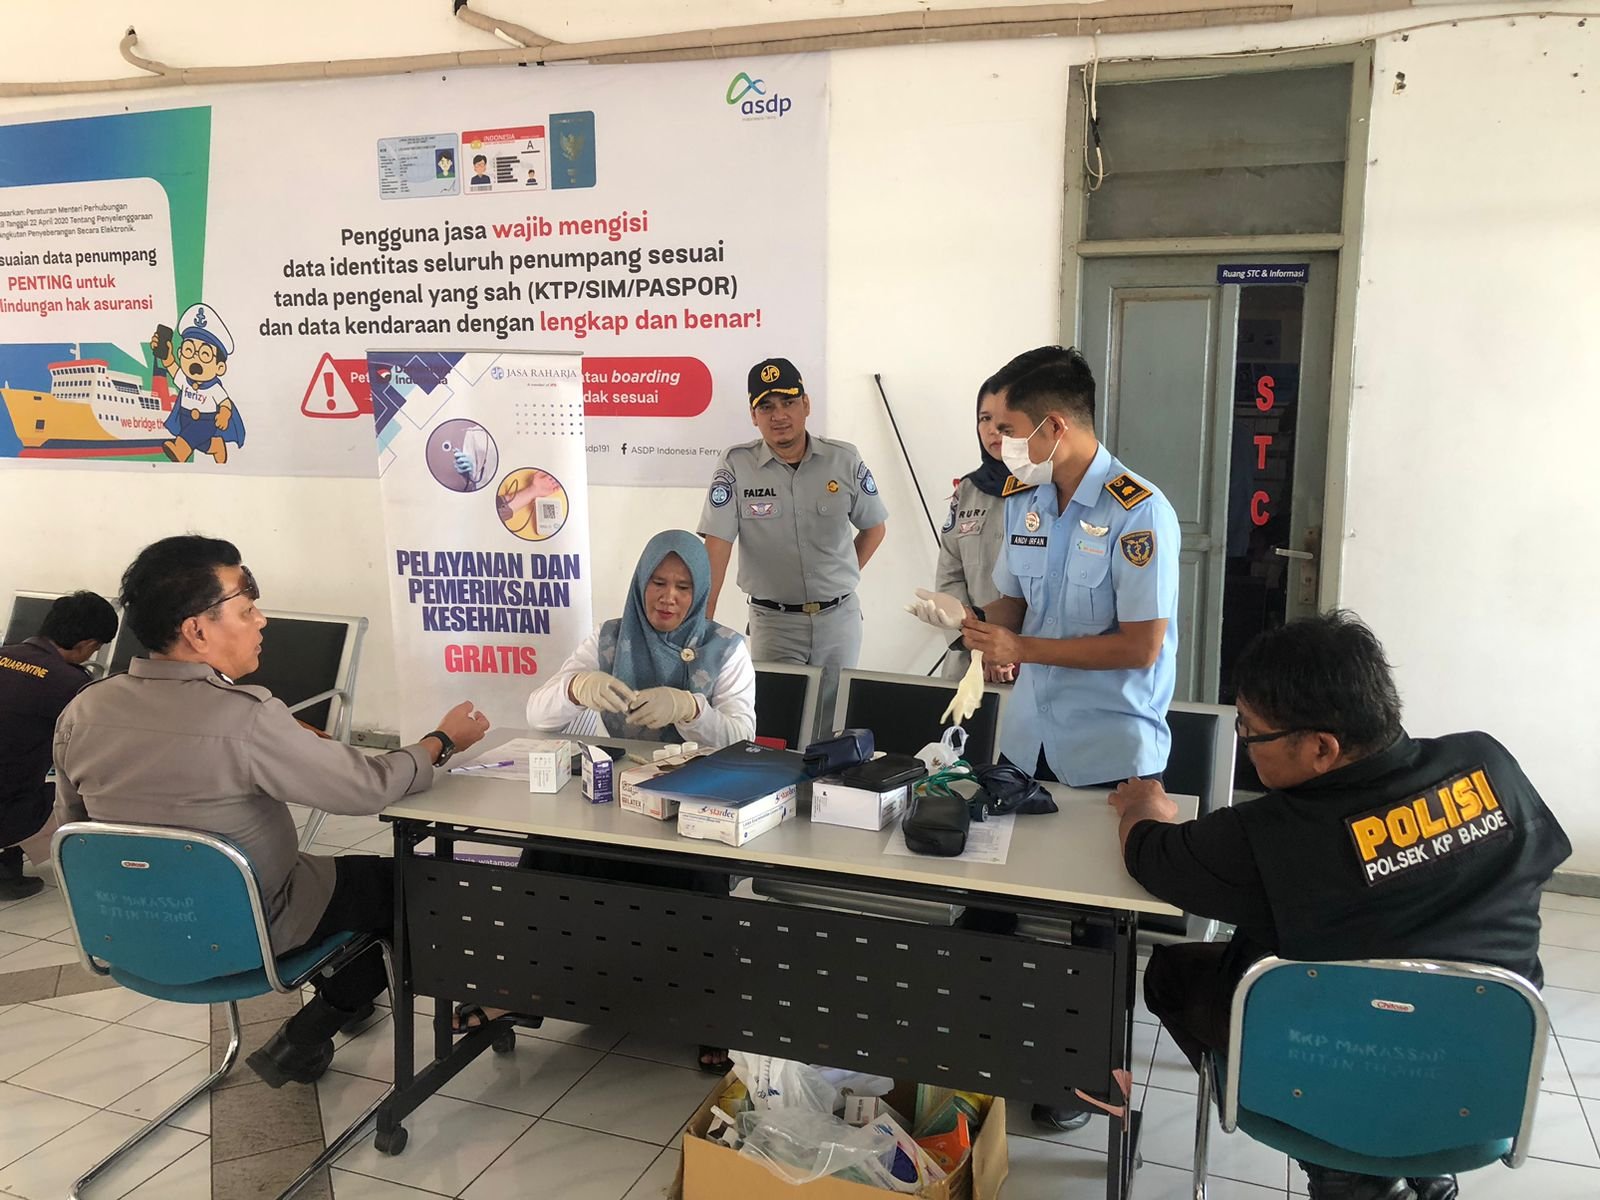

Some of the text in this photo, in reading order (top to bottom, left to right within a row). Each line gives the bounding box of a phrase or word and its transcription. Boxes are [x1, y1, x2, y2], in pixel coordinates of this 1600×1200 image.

[741, 93, 791, 117] asdp
[526, 140, 534, 150] A
[26, 206, 57, 215] Peraturan
[58, 204, 83, 213] Menteri
[84, 202, 128, 213] Perhubungan
[6, 219, 29, 230] Tanggal
[38, 217, 53, 227] April
[54, 217, 69, 225] 2020
[70, 215, 96, 225] Tentang
[97, 213, 153, 224] Penyelenggaraan
[341, 209, 648, 251] Pengguna jasa wajib mengisi
[28, 228, 76, 238] Penyeberangan
[77, 226, 100, 235] Secara
[100, 224, 136, 234] Elektronik.
[43, 250, 73, 265] data
[75, 248, 157, 267] penumpang
[283, 239, 724, 278] data identitas seluruh penumpang sesuai
[8, 274, 117, 291] PENTING untuk
[1222, 269, 1305, 279] Ruang STC & Informasi
[274, 275, 738, 312] tanda pengenal yang sah (KTP/SIM/PASPOR)
[66, 297, 91, 312] hak
[94, 294, 153, 311] asuransi
[259, 308, 762, 340] dan data kendaraan dengan lengkap dan benar!
[506, 368, 578, 380] JASA RAHARJA
[611, 369, 681, 386] boarding
[184, 387, 208, 404] ferizy
[583, 389, 659, 404] dak sesuai
[120, 418, 132, 428] we
[132, 415, 156, 431] bridge
[631, 445, 655, 456] ASDP
[656, 446, 697, 456] Indonesia
[699, 447, 722, 458] Ferry
[744, 487, 777, 498] FAIZAL
[958, 508, 987, 519] RURI
[1013, 536, 1045, 546] ANDI IRFAN
[396, 549, 581, 580] PELAYANAN DAN
[408, 578, 570, 608] PEMERIKSAAN
[422, 605, 551, 635] KESEHATAN
[0, 656, 49, 679] QUARANTINE
[444, 644, 538, 676] GRATIS
[1351, 770, 1499, 862] POLISI
[1365, 810, 1508, 882] POLSEK KP BAJOE
[1376, 1001, 1410, 1011] Chitose
